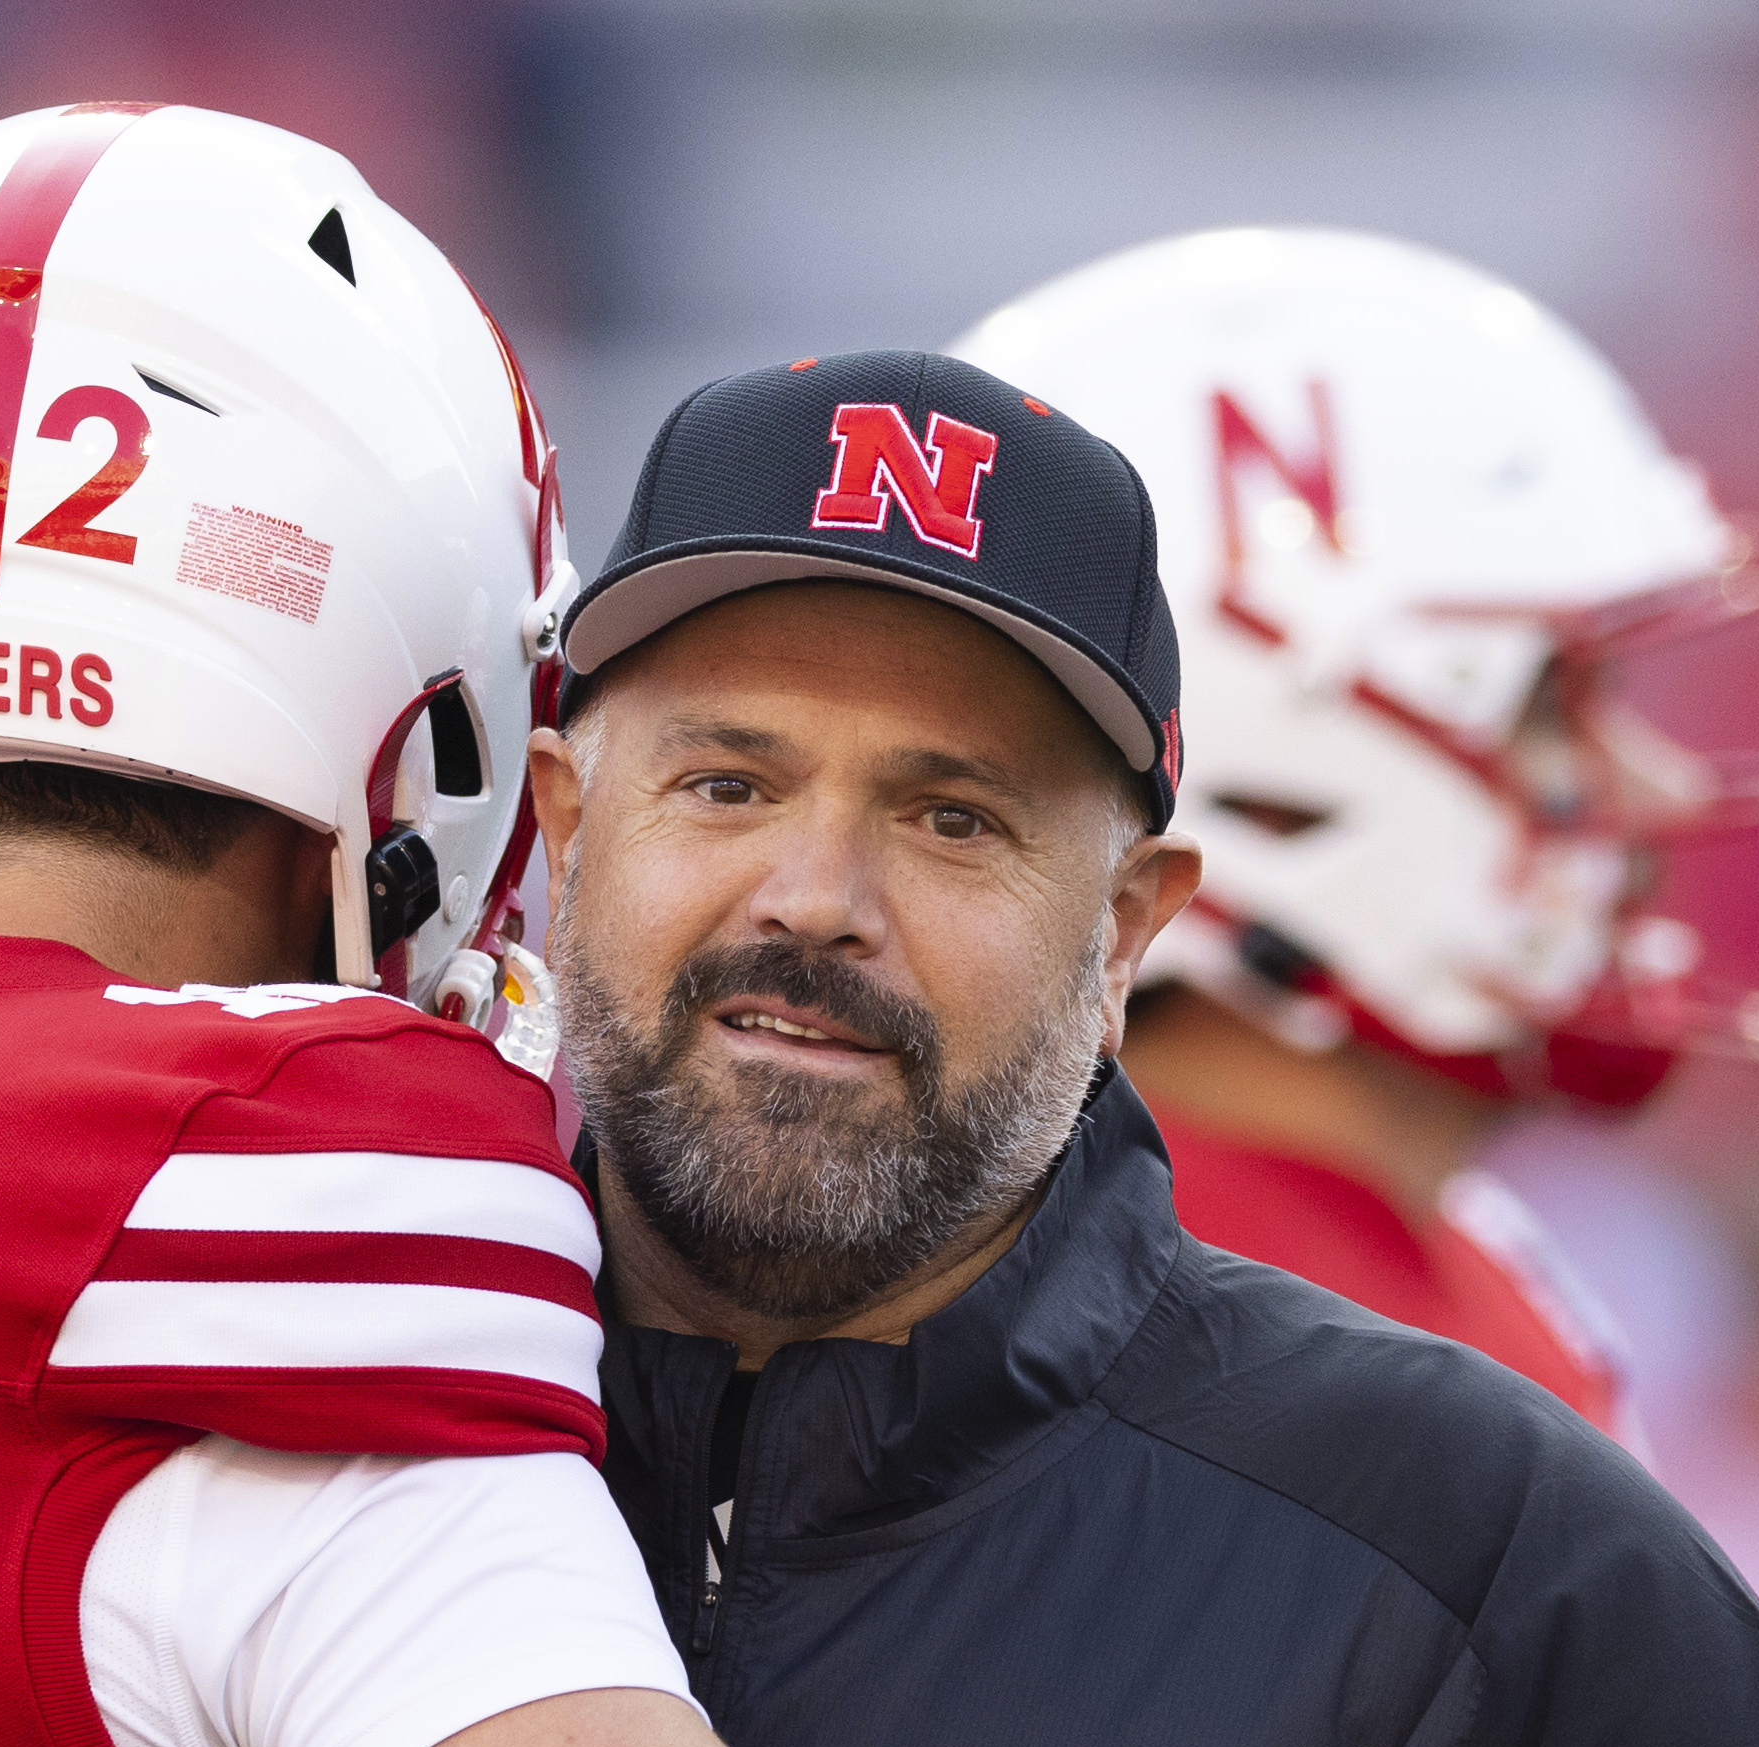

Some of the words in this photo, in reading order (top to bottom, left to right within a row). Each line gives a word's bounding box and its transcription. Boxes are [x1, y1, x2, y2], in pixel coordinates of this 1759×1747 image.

[232, 504, 303, 533] WARNING
[811, 402, 999, 560] N
[1209, 378, 1344, 652] N
